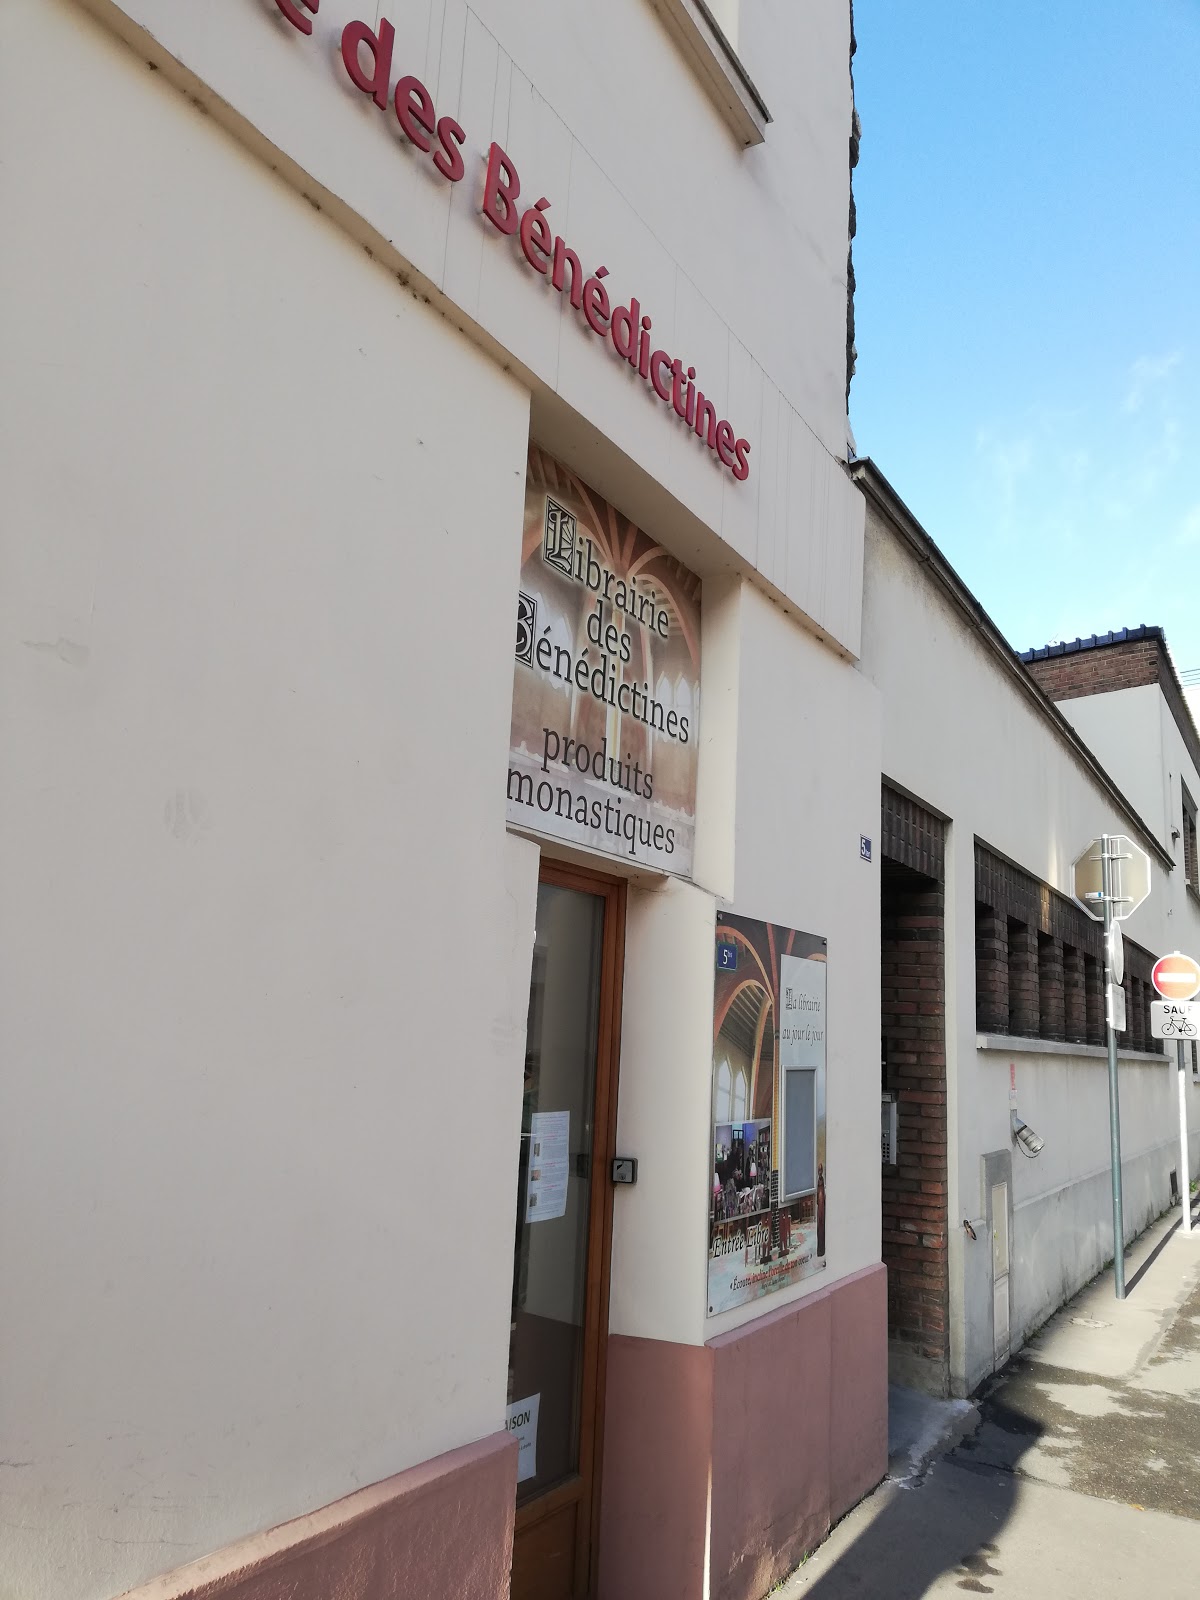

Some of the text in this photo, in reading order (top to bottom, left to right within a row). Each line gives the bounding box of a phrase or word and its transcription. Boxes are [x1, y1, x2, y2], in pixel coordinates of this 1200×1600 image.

[341, 17, 751, 481] des Bénédictines
[543, 495, 669, 639] Librairie
[587, 600, 631, 663] des
[541, 727, 654, 800] produits
[506, 768, 676, 855] monastiques
[798, 993, 821, 1012] librairie
[1163, 1004, 1193, 1015] SAUF
[782, 1024, 824, 1047] au jour le jour
[712, 1229, 745, 1258] Entrée
